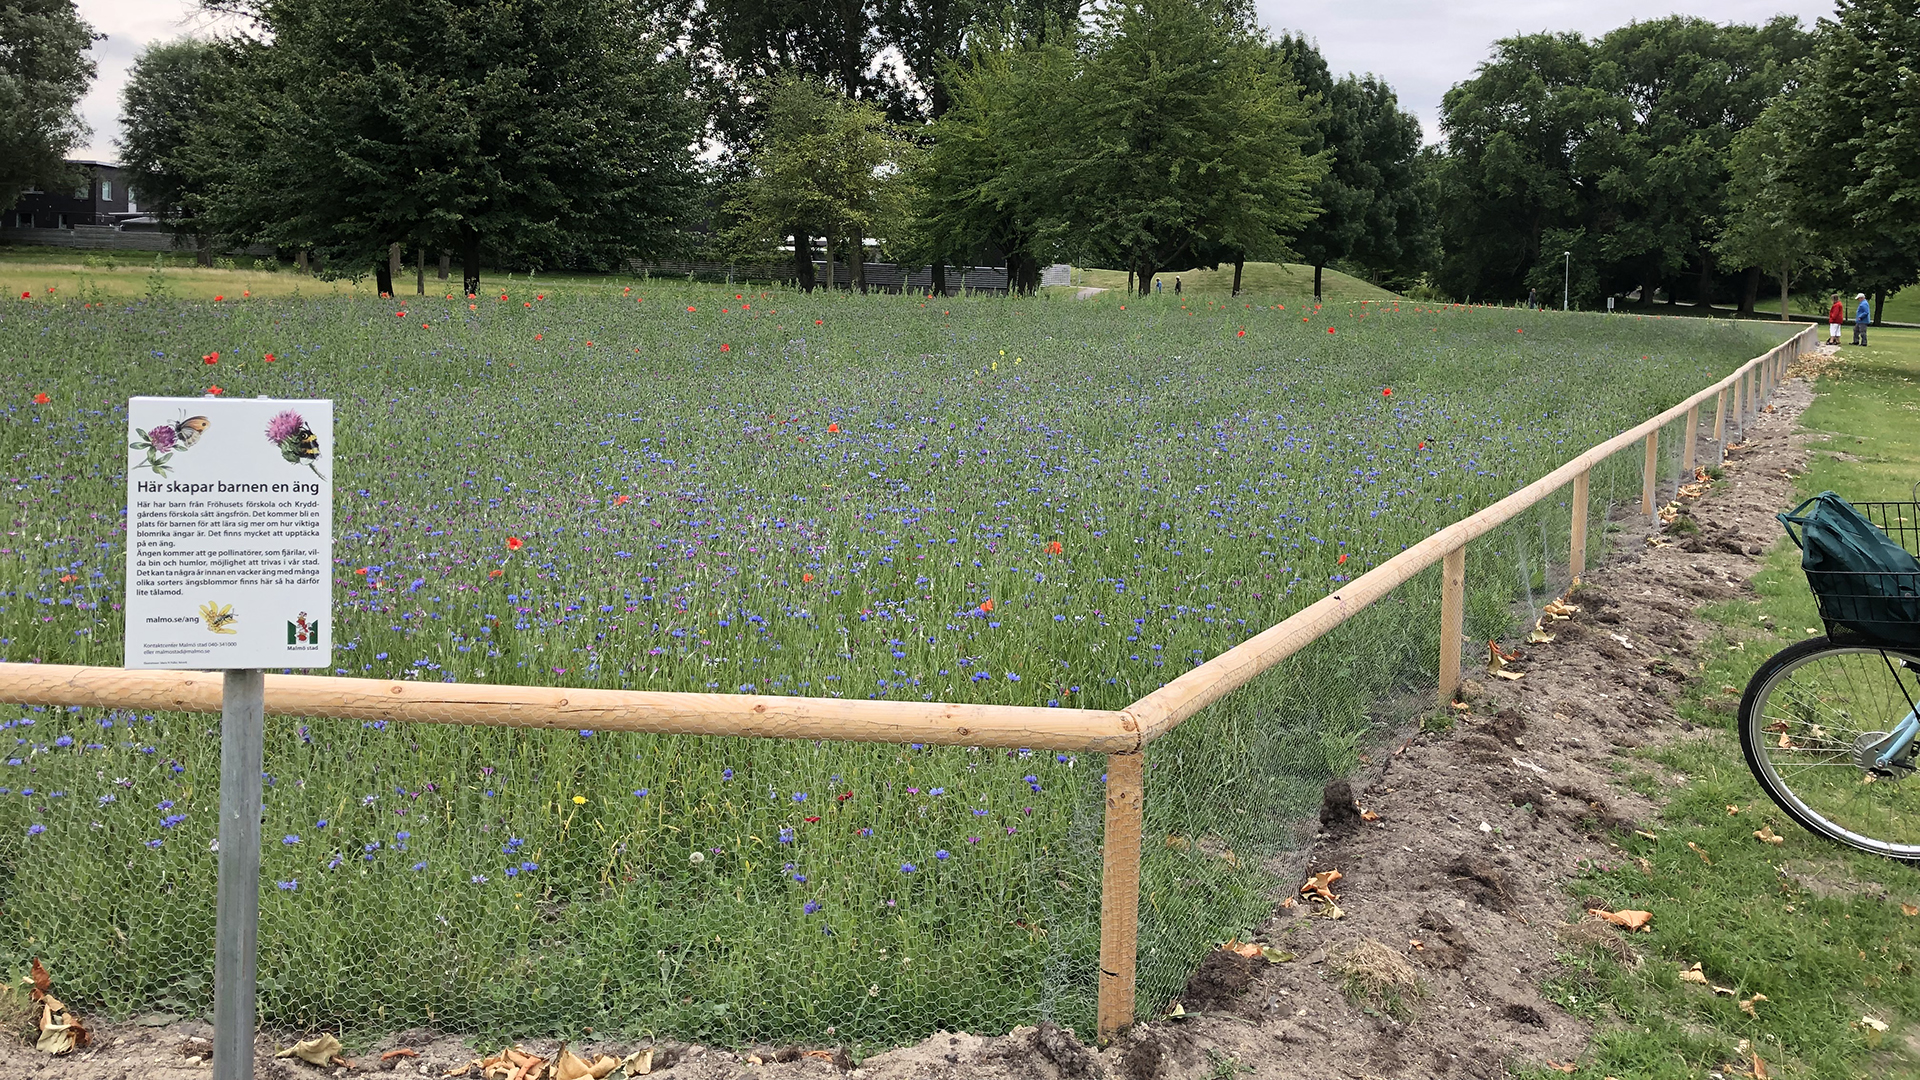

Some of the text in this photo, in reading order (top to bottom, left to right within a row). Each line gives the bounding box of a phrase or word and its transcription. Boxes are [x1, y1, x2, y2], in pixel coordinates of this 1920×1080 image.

[137, 481, 319, 495] Här skapar barnen en äng
[295, 501, 319, 509] Krydd-
[137, 511, 167, 519] gårdens
[215, 511, 251, 519] ängsfrön.
[294, 520, 319, 528] viktiga
[137, 540, 146, 548] på
[159, 540, 175, 548] äng.
[136, 549, 162, 557] Ängen
[282, 549, 307, 557] fjärilar,
[210, 559, 246, 567] möjlighet
[174, 569, 195, 577] några
[294, 568, 319, 577] många
[185, 579, 238, 587] ängsblommor
[146, 616, 199, 624] malmo.se/ang
